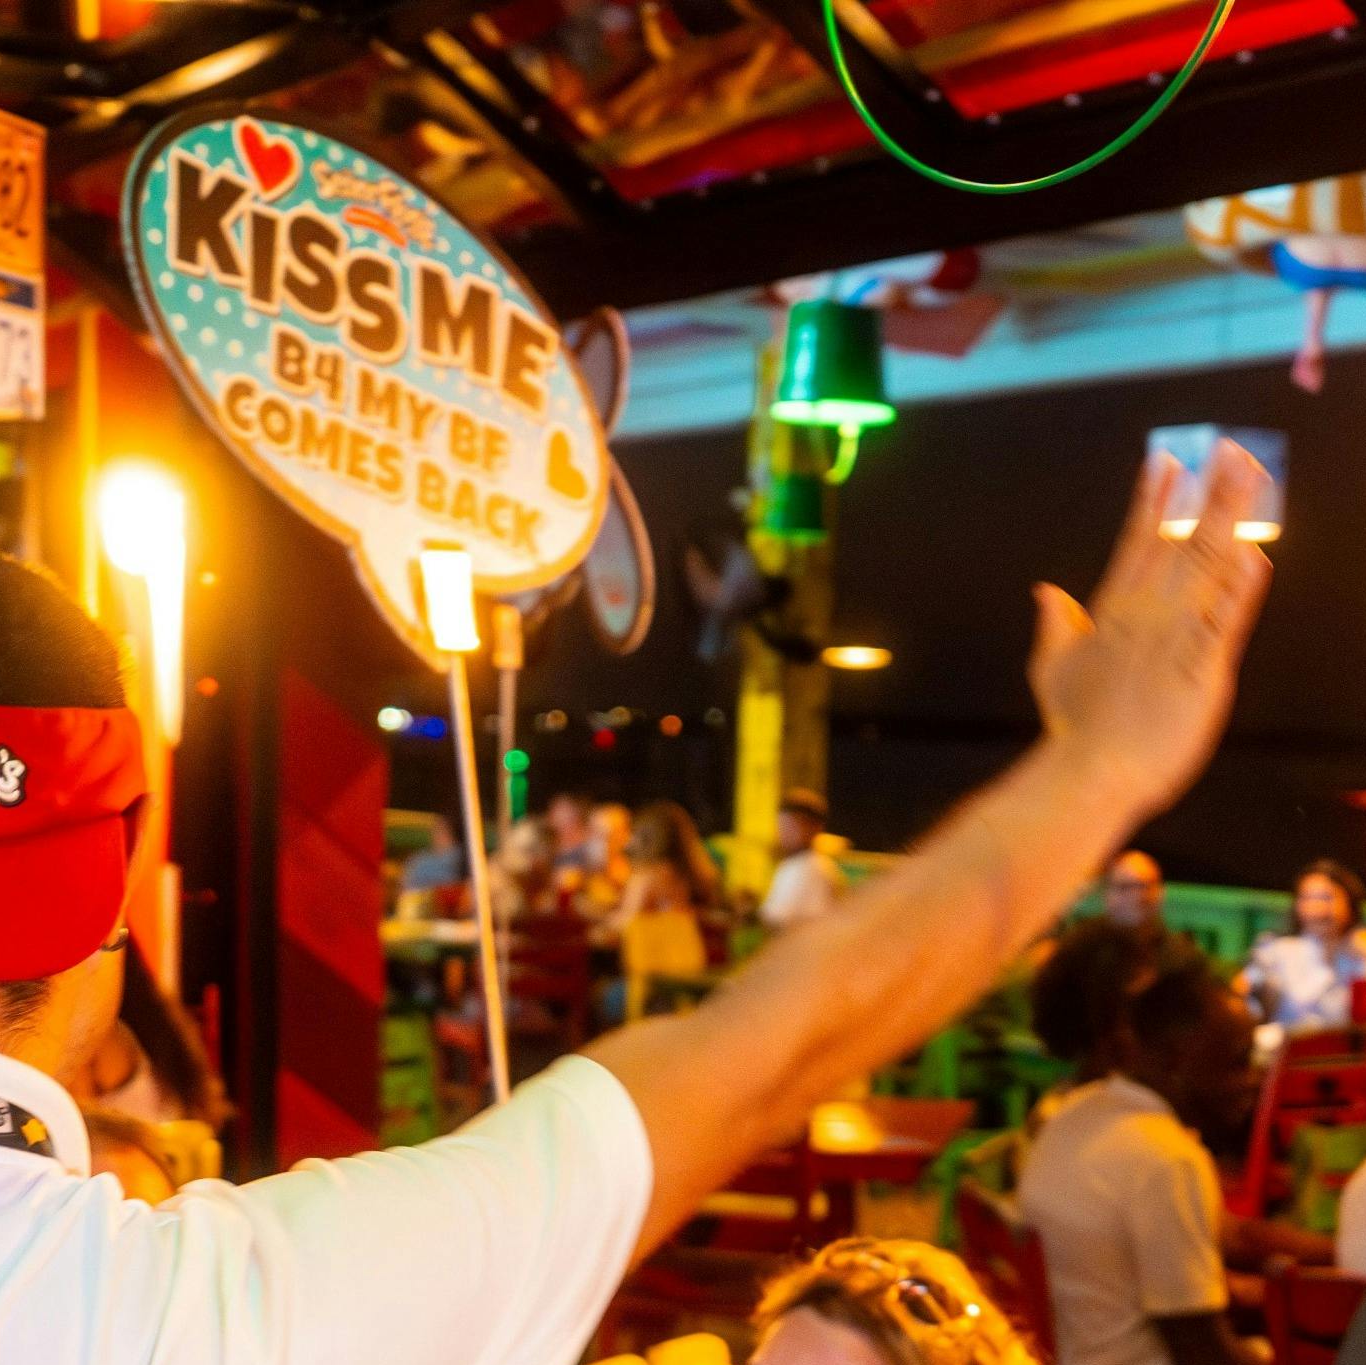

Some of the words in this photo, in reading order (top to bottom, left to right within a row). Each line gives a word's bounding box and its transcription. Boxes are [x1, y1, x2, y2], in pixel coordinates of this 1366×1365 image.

[168, 148, 407, 362] KISS
[410, 257, 561, 419] ME
[221, 378, 405, 496] COMES
[415, 461, 539, 549] BACK
[271, 327, 345, 408] B4
[355, 366, 440, 443] MY
[447, 408, 510, 472] BF
